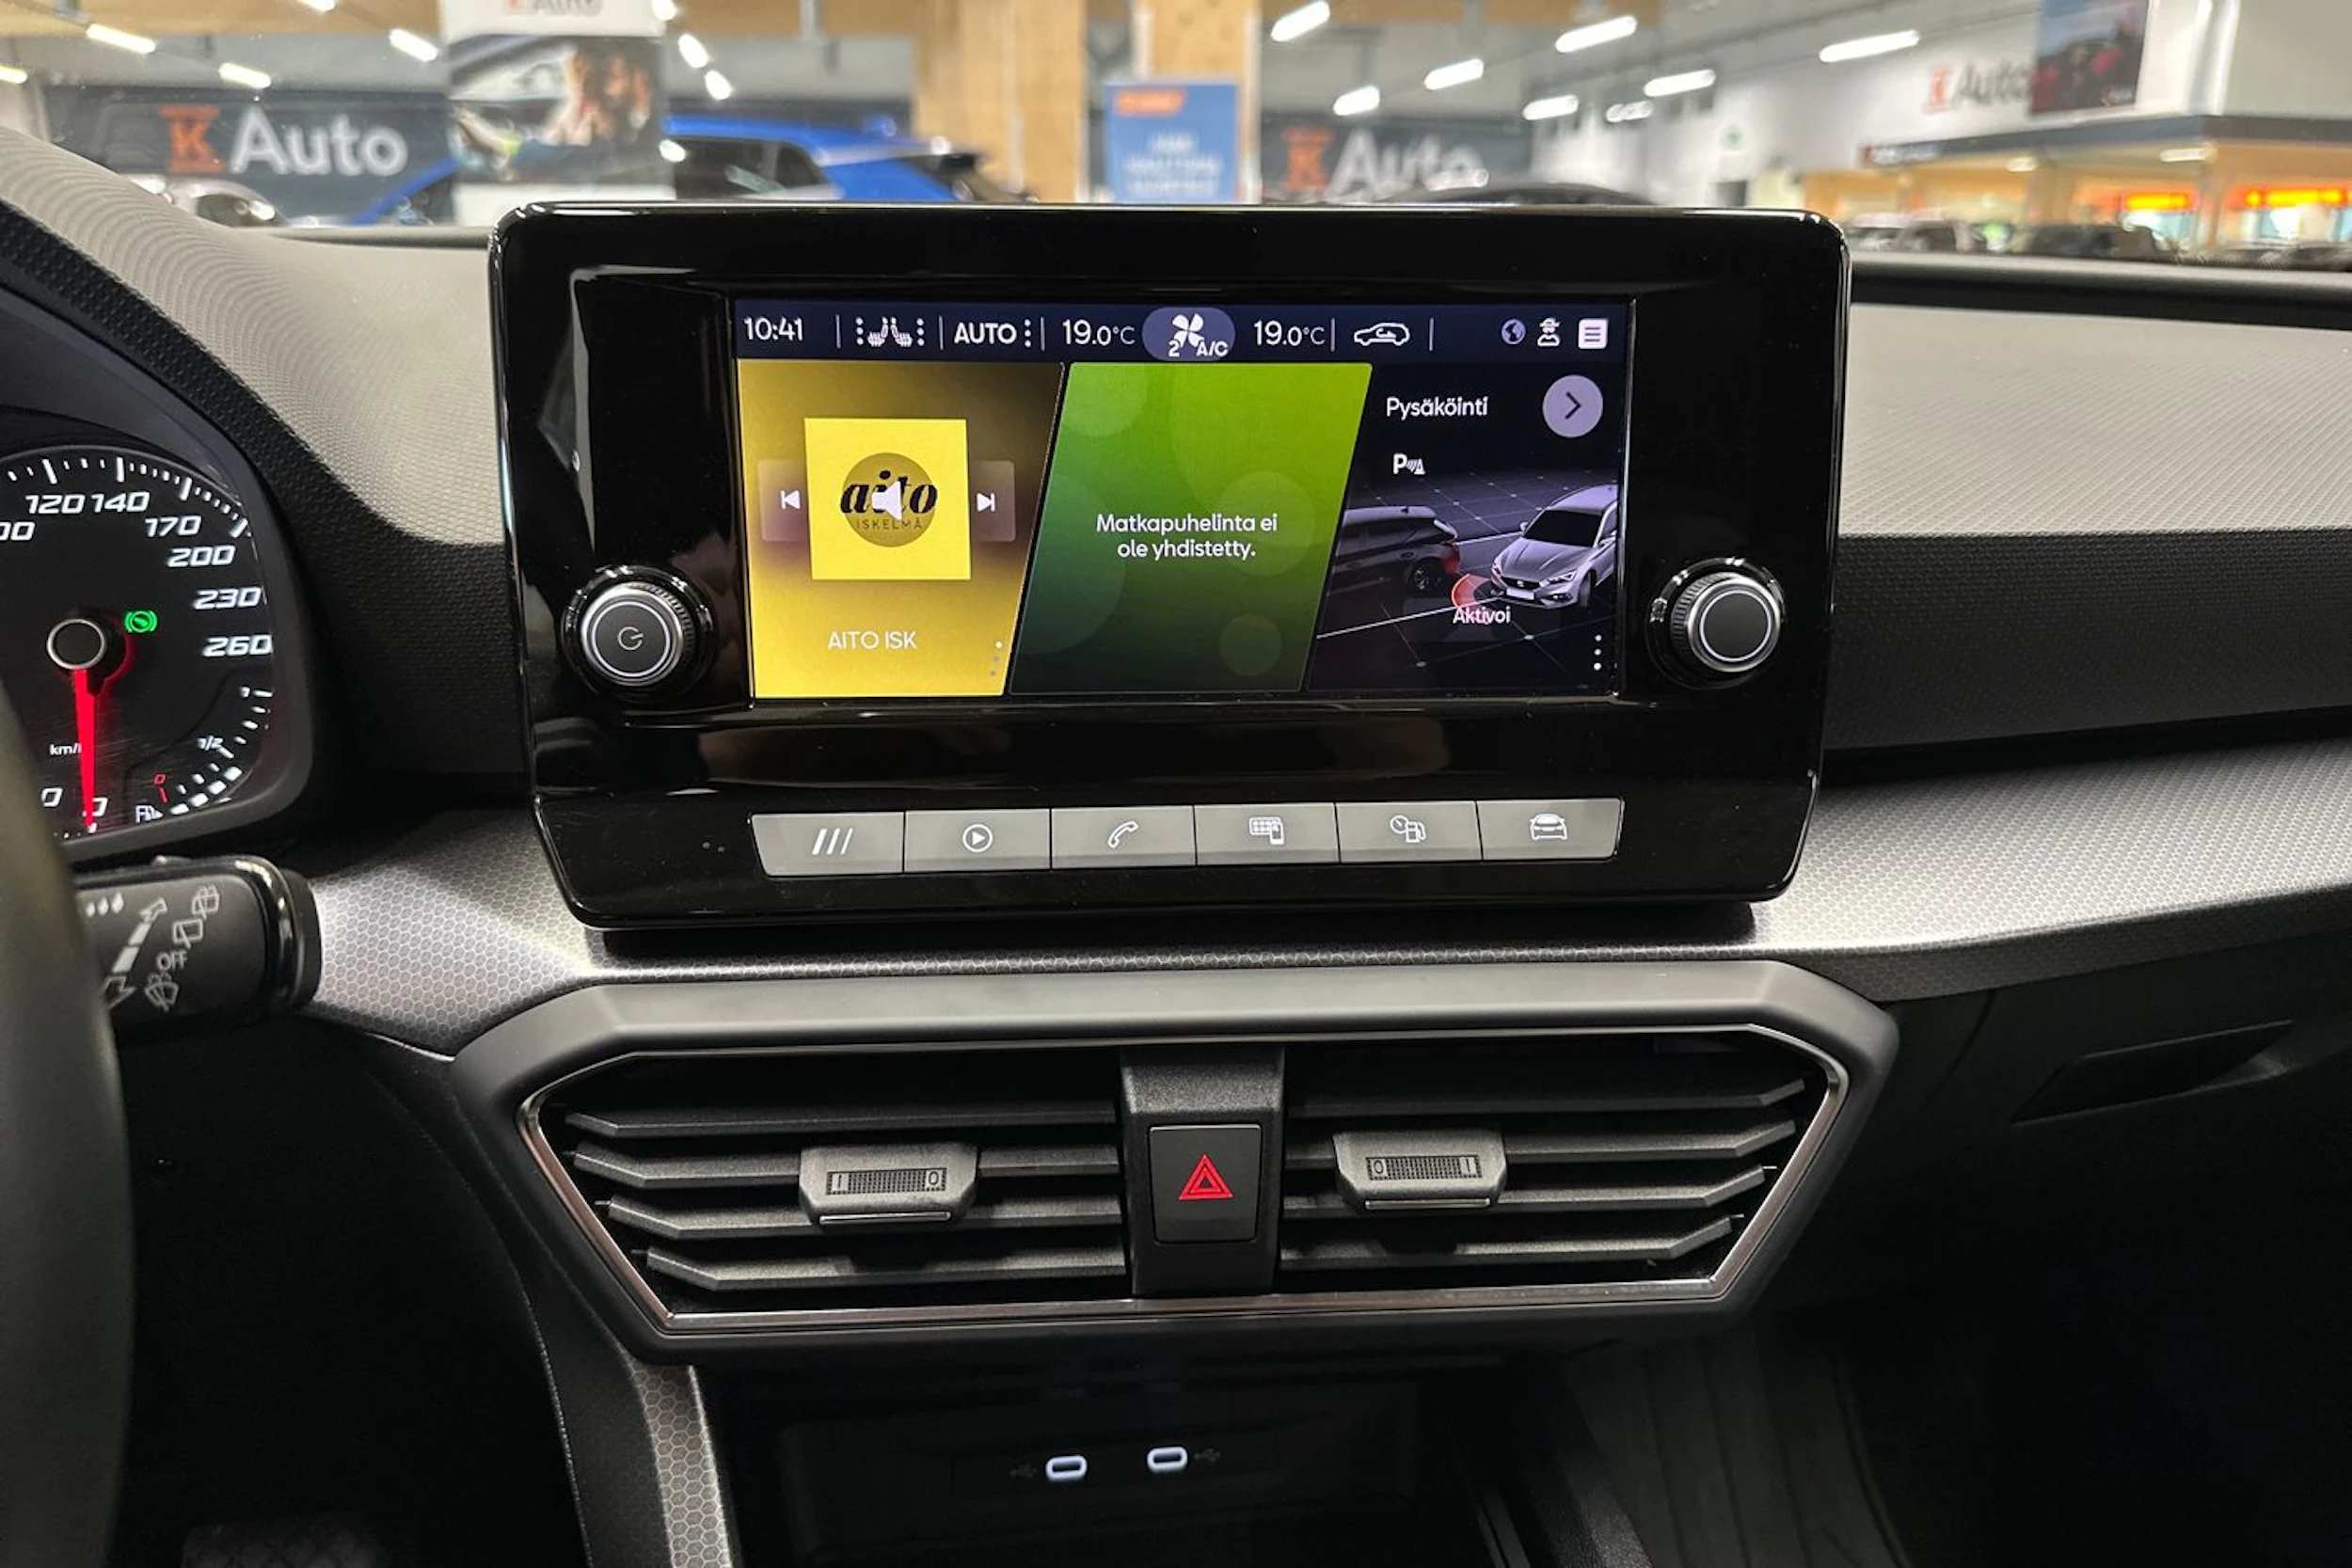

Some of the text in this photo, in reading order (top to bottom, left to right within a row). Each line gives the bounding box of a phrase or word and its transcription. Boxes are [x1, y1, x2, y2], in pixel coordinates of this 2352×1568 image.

[229, 105, 408, 176] Auto
[743, 317, 803, 341] 10:41
[954, 323, 1017, 344] AUTO
[1196, 341, 1230, 357] A/C
[1386, 395, 1489, 420] Pysäköinti
[24, 494, 86, 515] 120
[90, 491, 151, 513] 140
[144, 515, 201, 537] 170
[1096, 514, 1278, 535] Matkapuhelinta ei
[167, 545, 235, 567] 200
[1117, 539, 1256, 561] ole yhdistetty.
[193, 587, 262, 610] 230
[1452, 608, 1511, 625] Aktivoi
[201, 634, 273, 657] 260
[827, 630, 917, 650] AITO ISK
[49, 742, 82, 755] km/
[156, 950, 189, 972] OFF
